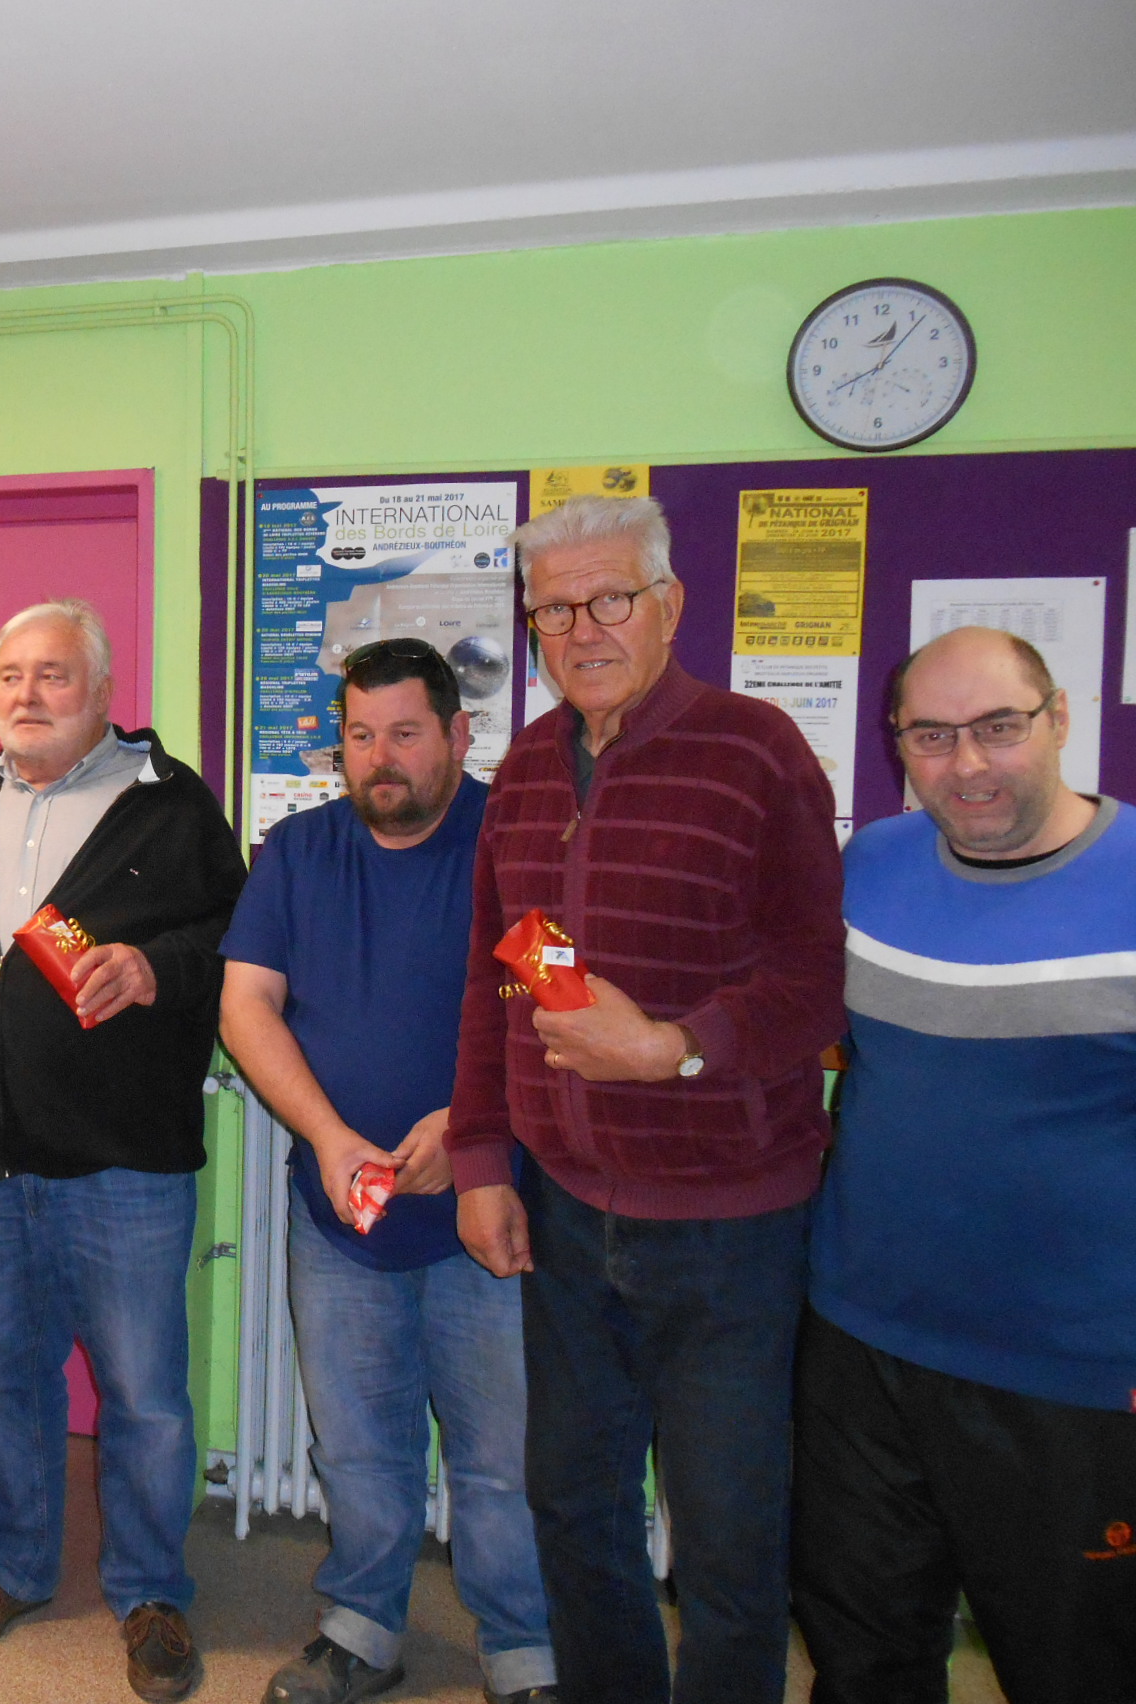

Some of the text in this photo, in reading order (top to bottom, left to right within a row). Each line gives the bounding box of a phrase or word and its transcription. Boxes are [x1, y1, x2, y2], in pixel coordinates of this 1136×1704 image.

[873, 304, 890, 316] 12
[909, 310, 915, 321] 1
[843, 314, 859, 326] 11
[930, 329, 939, 340] 2
[821, 338, 838, 349] 10
[939, 357, 948, 368] 3
[813, 365, 822, 376] 9
[873, 417, 883, 429] 6
[380, 496, 390, 504] Du
[415, 494, 425, 502] 21
[427, 494, 442, 502] mai
[444, 493, 464, 502] 2017
[261, 501, 318, 511] AU PROGRAMME
[335, 504, 509, 526] INTERNATIONAL
[770, 508, 857, 518] NATIONAL
[335, 521, 509, 541] des Bords de Loire
[821, 529, 852, 537] 2017
[372, 540, 467, 551] ANDRÉZIEUX-BOUTHÉON
[795, 621, 831, 629] GRIGNAN
[815, 680, 842, 688] L'AMITIE
[790, 698, 812, 708] JUIN
[815, 698, 838, 708] 2017
